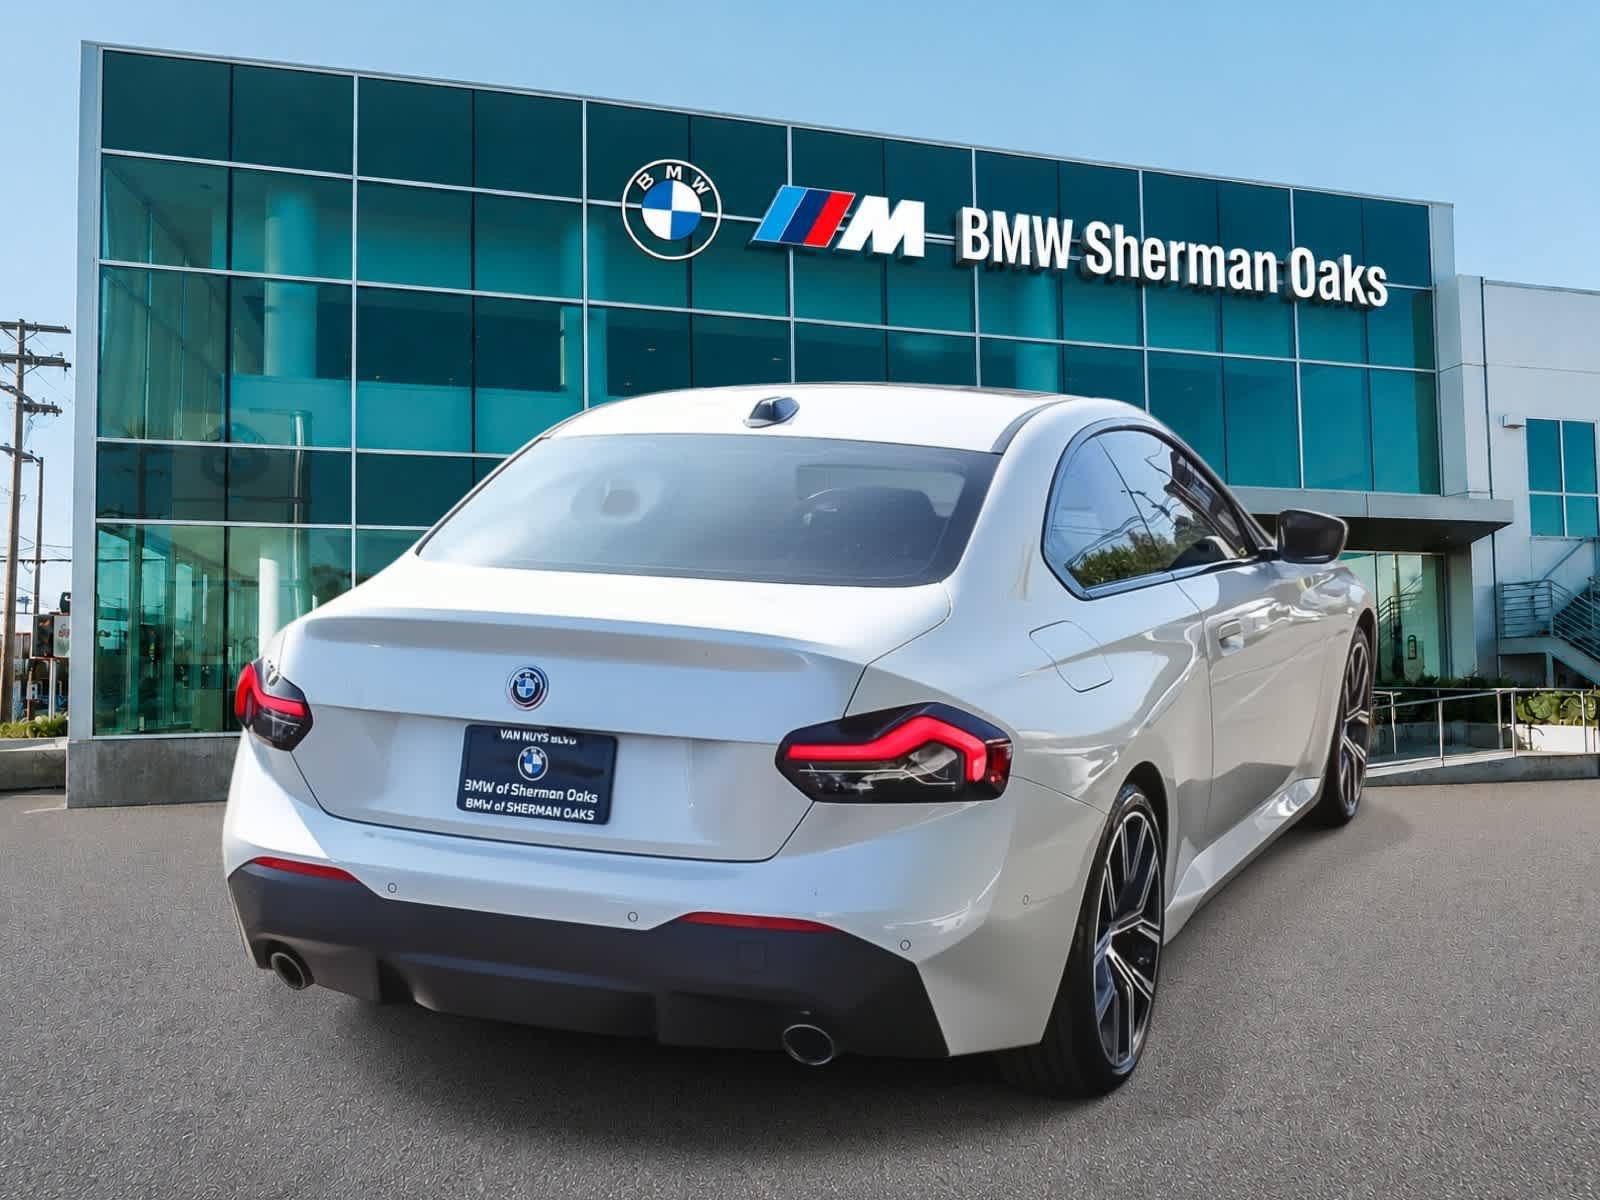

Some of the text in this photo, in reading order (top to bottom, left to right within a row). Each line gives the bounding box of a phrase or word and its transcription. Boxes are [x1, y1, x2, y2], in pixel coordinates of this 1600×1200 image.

[637, 165, 710, 194] BMW
[836, 195, 925, 257] M
[961, 207, 1389, 308] BMW Sherman Oaks
[500, 729, 520, 740] VAN
[522, 731, 549, 743] NUYS
[496, 782, 510, 794] of
[510, 783, 564, 801] Sherman
[566, 788, 598, 803] Oaks
[466, 797, 595, 821] BMW of SHERMAN OAKS
